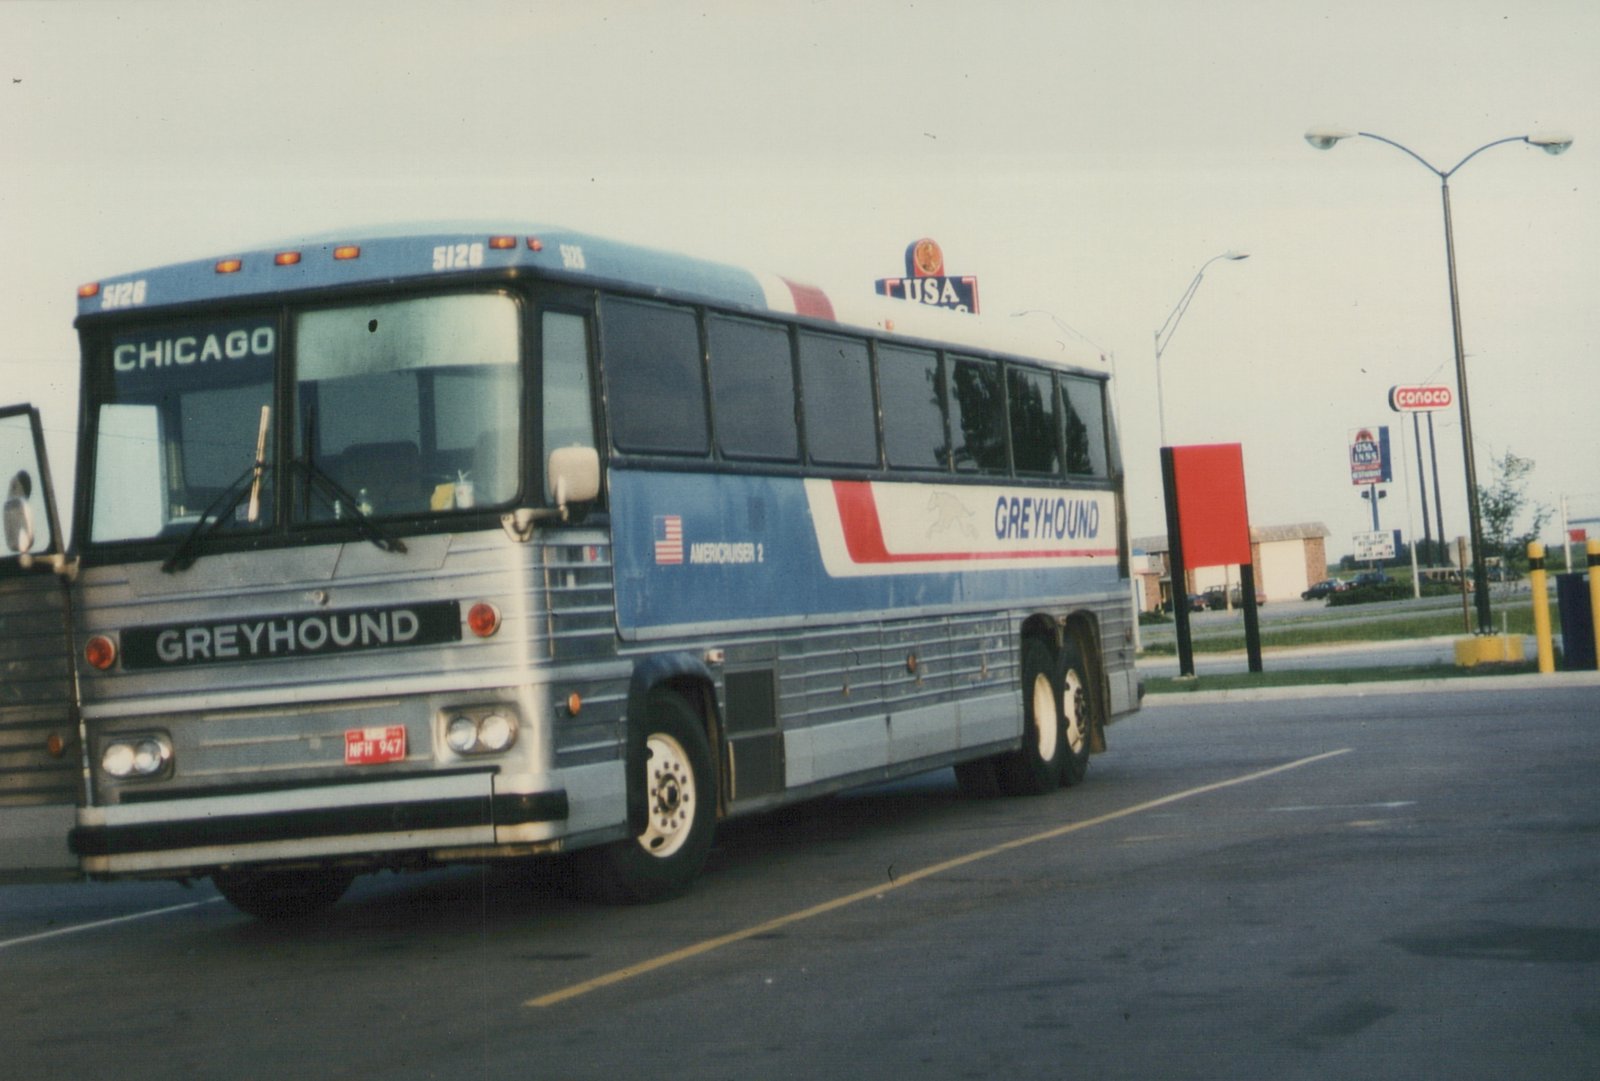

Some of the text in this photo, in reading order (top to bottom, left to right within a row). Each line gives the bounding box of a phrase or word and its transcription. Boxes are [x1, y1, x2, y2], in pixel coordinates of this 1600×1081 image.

[432, 243, 484, 271] 5126
[101, 279, 147, 310] 5126
[903, 278, 960, 305] USA
[113, 326, 276, 371] CHICAGO
[995, 496, 1099, 540] GREYHOUND
[689, 542, 764, 564] AMERICRUISER 2
[156, 610, 420, 662] GREYHOUND
[379, 739, 402, 755] 947
